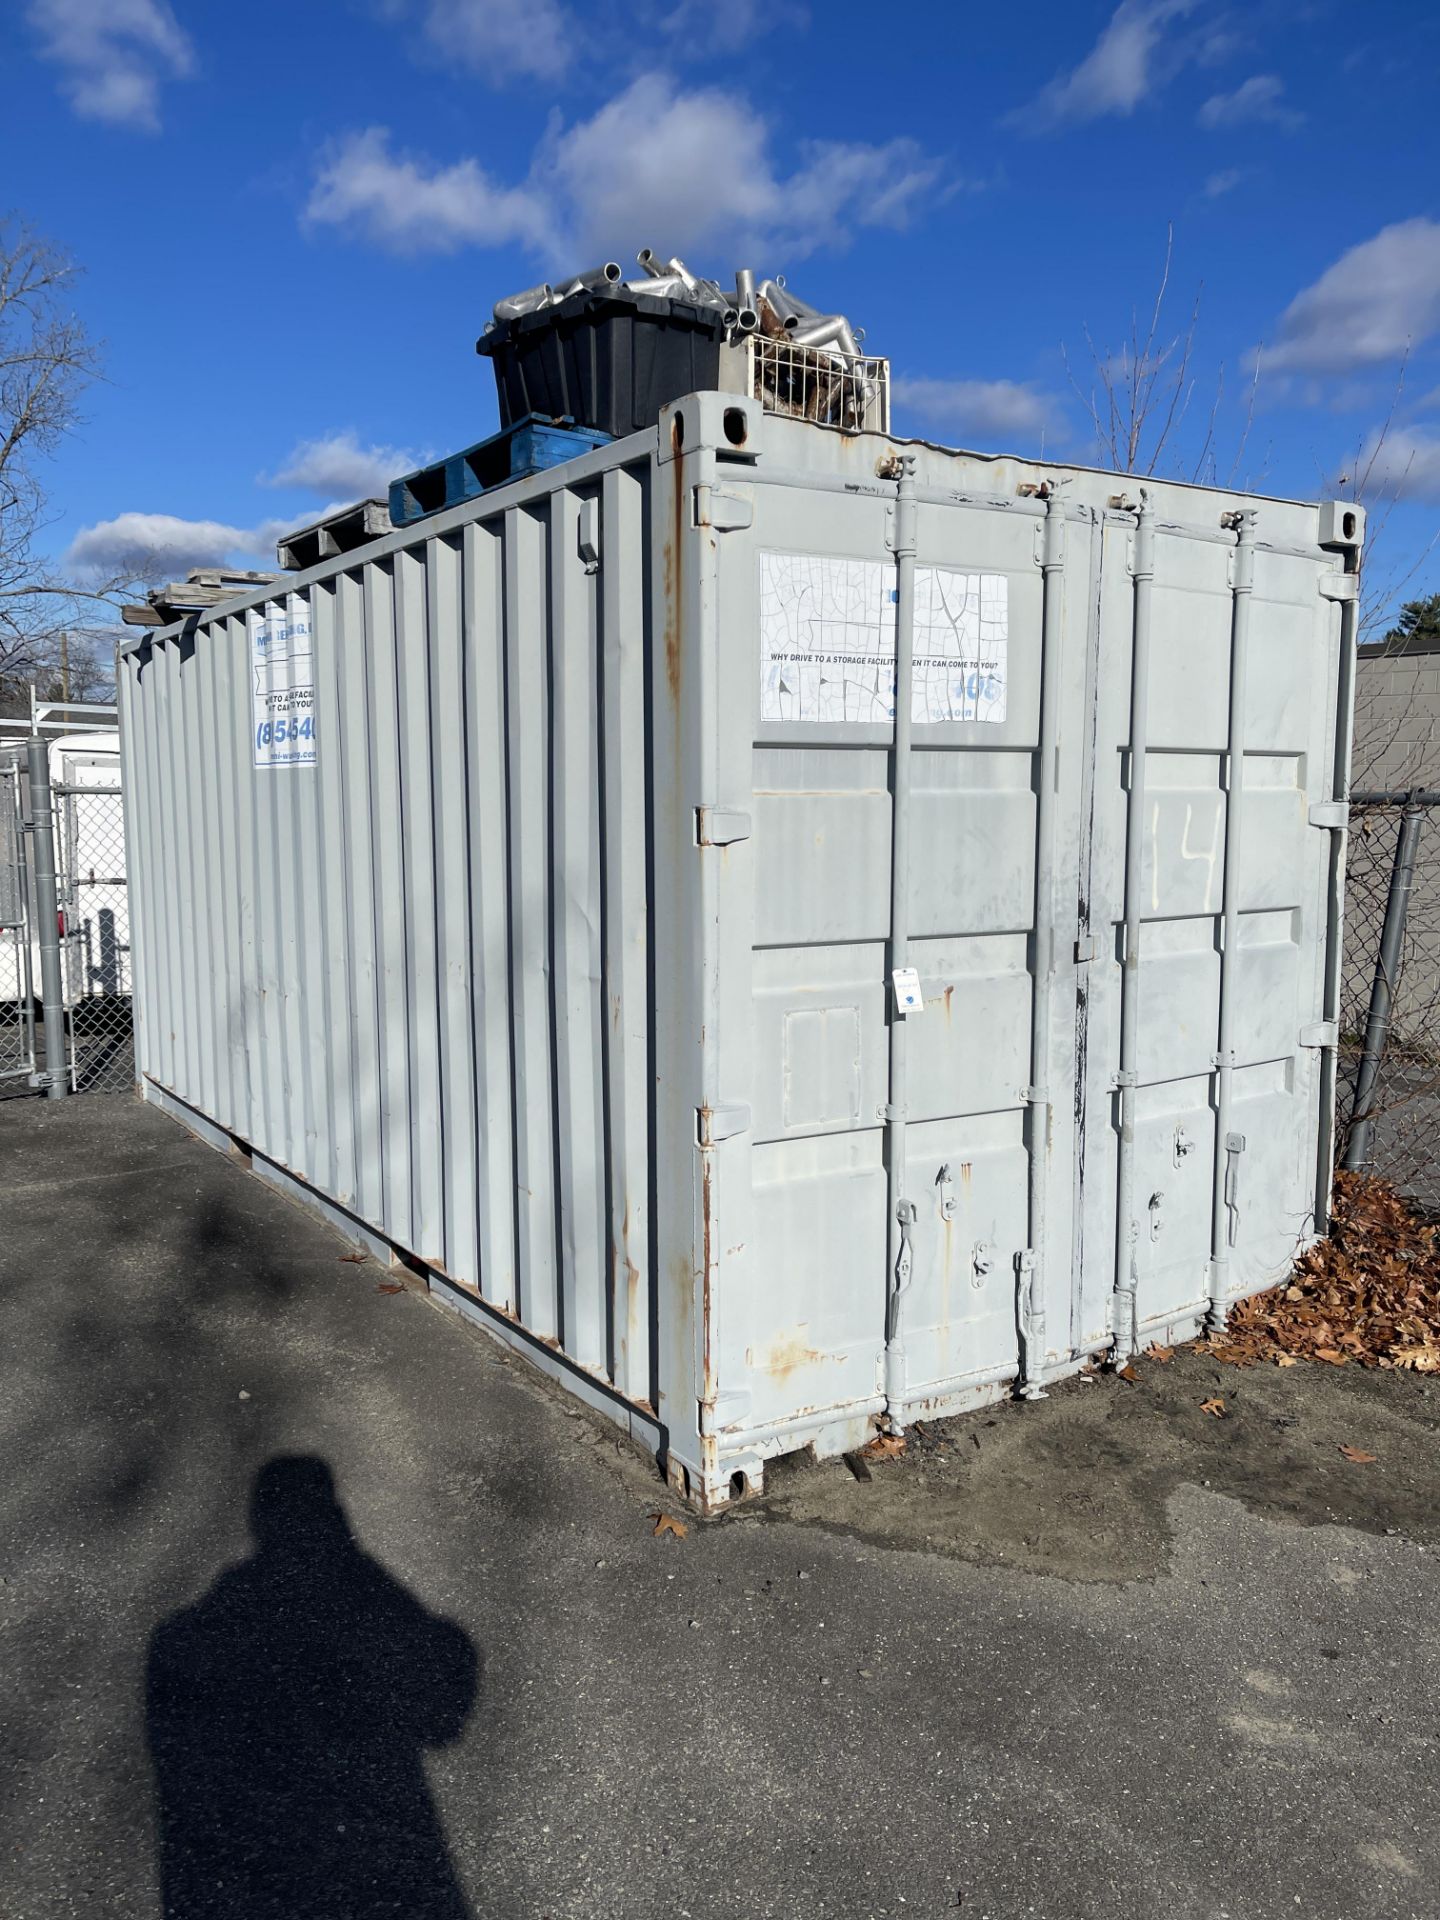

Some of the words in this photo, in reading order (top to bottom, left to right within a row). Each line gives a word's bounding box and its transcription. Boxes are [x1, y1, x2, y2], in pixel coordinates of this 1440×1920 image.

[770, 652, 789, 661] WHY
[790, 653, 813, 662] DRIVE
[815, 655, 825, 663] TO
[826, 655, 832, 663] A
[833, 656, 866, 665] STORAGE
[932, 660, 947, 668] CAN
[948, 661, 968, 669] COME
[969, 661, 979, 669] TO
[981, 662, 998, 670] YOU?
[1151, 801, 1222, 913] 14
